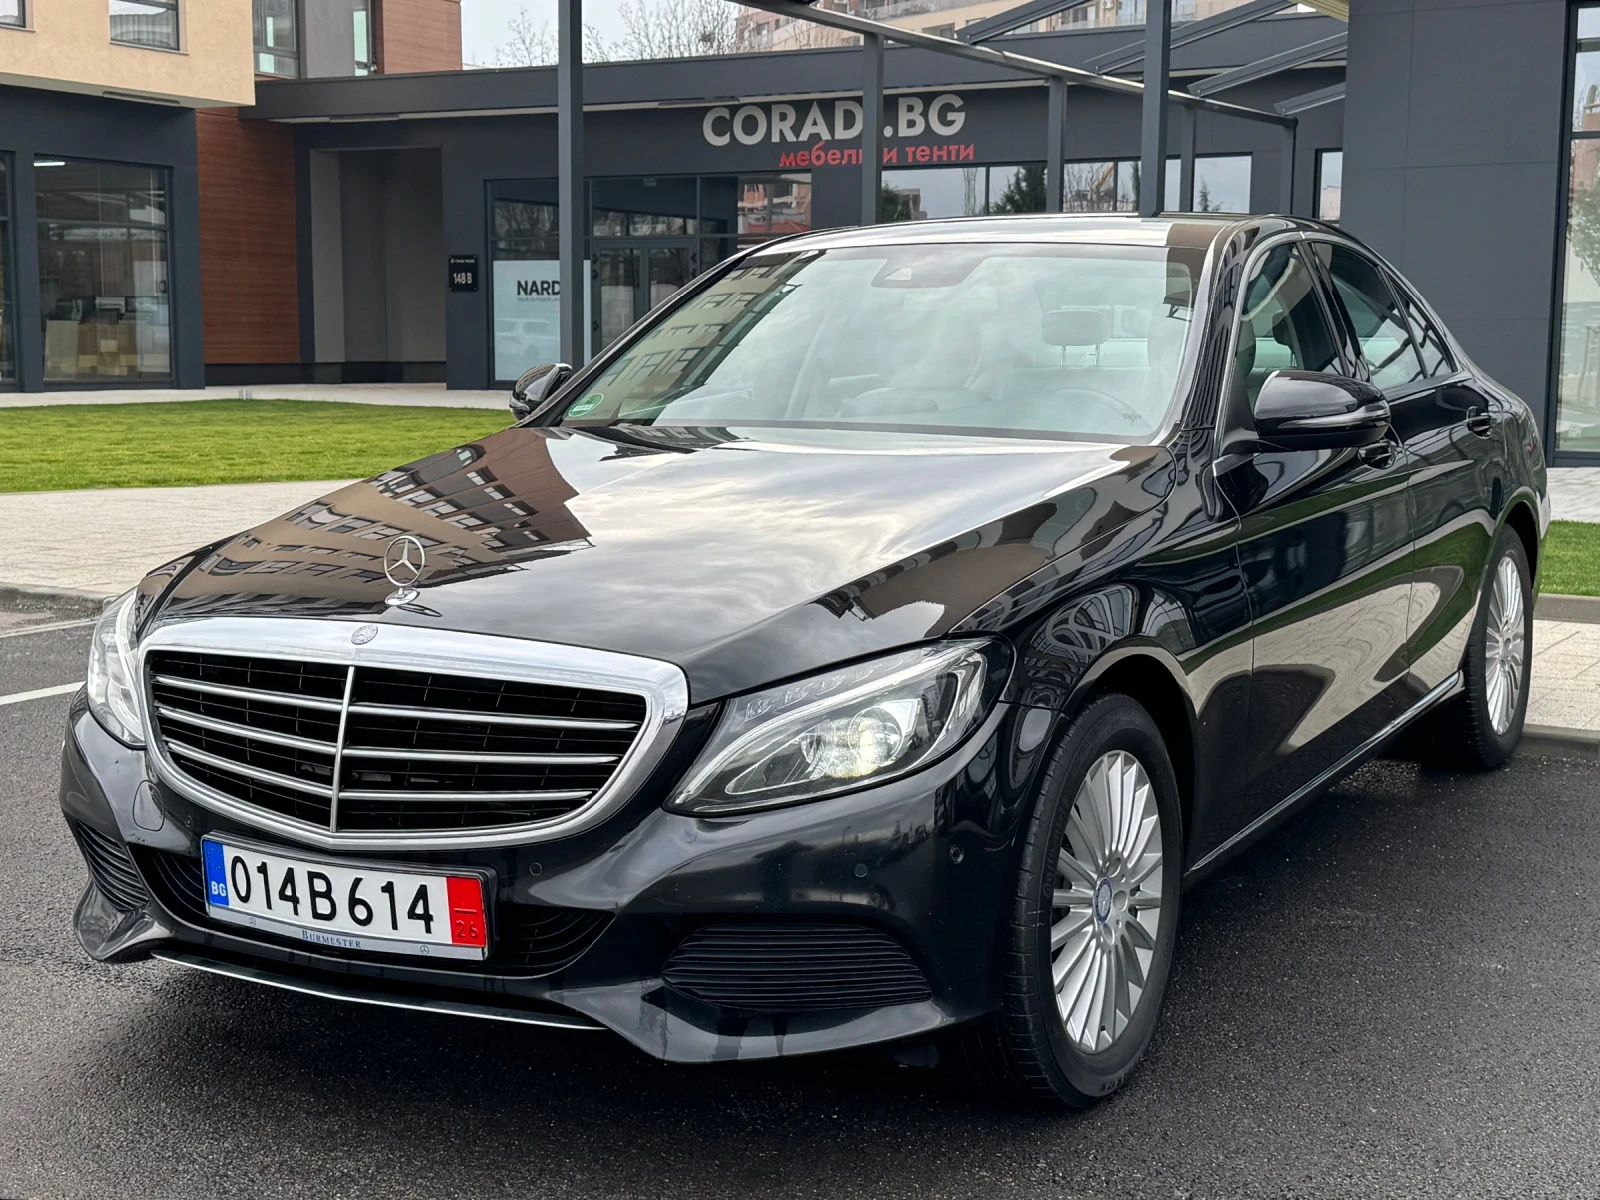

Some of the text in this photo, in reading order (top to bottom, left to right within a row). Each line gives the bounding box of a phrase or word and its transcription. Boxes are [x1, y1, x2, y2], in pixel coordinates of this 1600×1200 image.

[702, 94, 966, 147] CORAD.BG
[779, 140, 975, 167] мебел и тенти
[211, 880, 227, 897] BG
[456, 919, 479, 938] 26
[302, 930, 362, 949] BURMESTER
